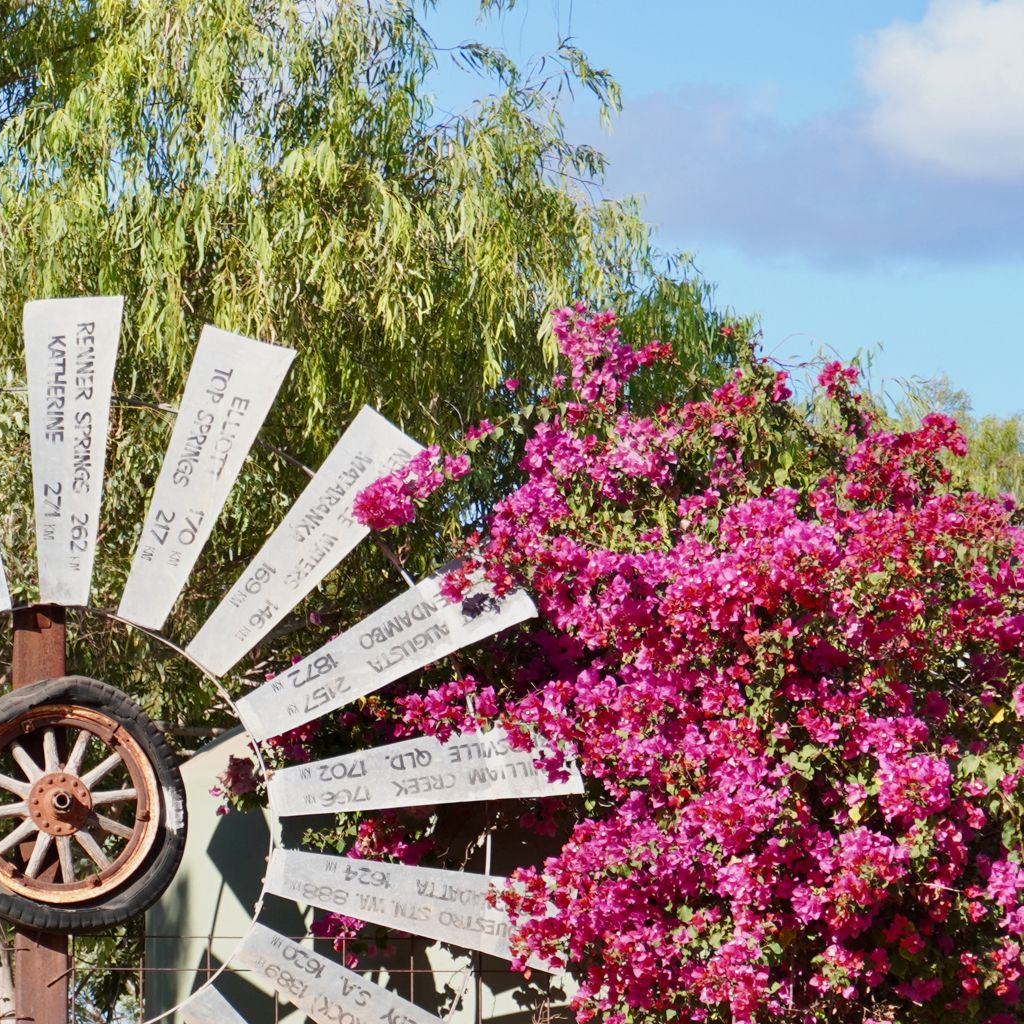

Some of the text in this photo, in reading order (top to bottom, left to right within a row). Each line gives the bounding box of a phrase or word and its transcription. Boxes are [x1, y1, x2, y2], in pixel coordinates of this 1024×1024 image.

[42, 335, 67, 540] KATHERINE 271 KM
[68, 321, 95, 571] RENNER SPRINGS 262 KM
[140, 363, 233, 561] TOP SPRINGS 217 KM
[166, 393, 249, 567] ELLIOTT 170 KM
[241, 559, 278, 598] 169
[281, 528, 339, 593] WATERS
[247, 597, 279, 632] 146
[366, 619, 451, 675] AUGUSTA
[286, 651, 338, 690] 1872
[297, 673, 352, 714] 2157
[317, 759, 367, 782] 1702
[384, 747, 432, 771] QLD.
[390, 772, 457, 796] CREEK
[300, 882, 349, 906] 888
[340, 863, 392, 889] 1624
[260, 960, 310, 1000] 1389
[279, 941, 328, 980] 1620
[332, 974, 373, 1009] S.A.
